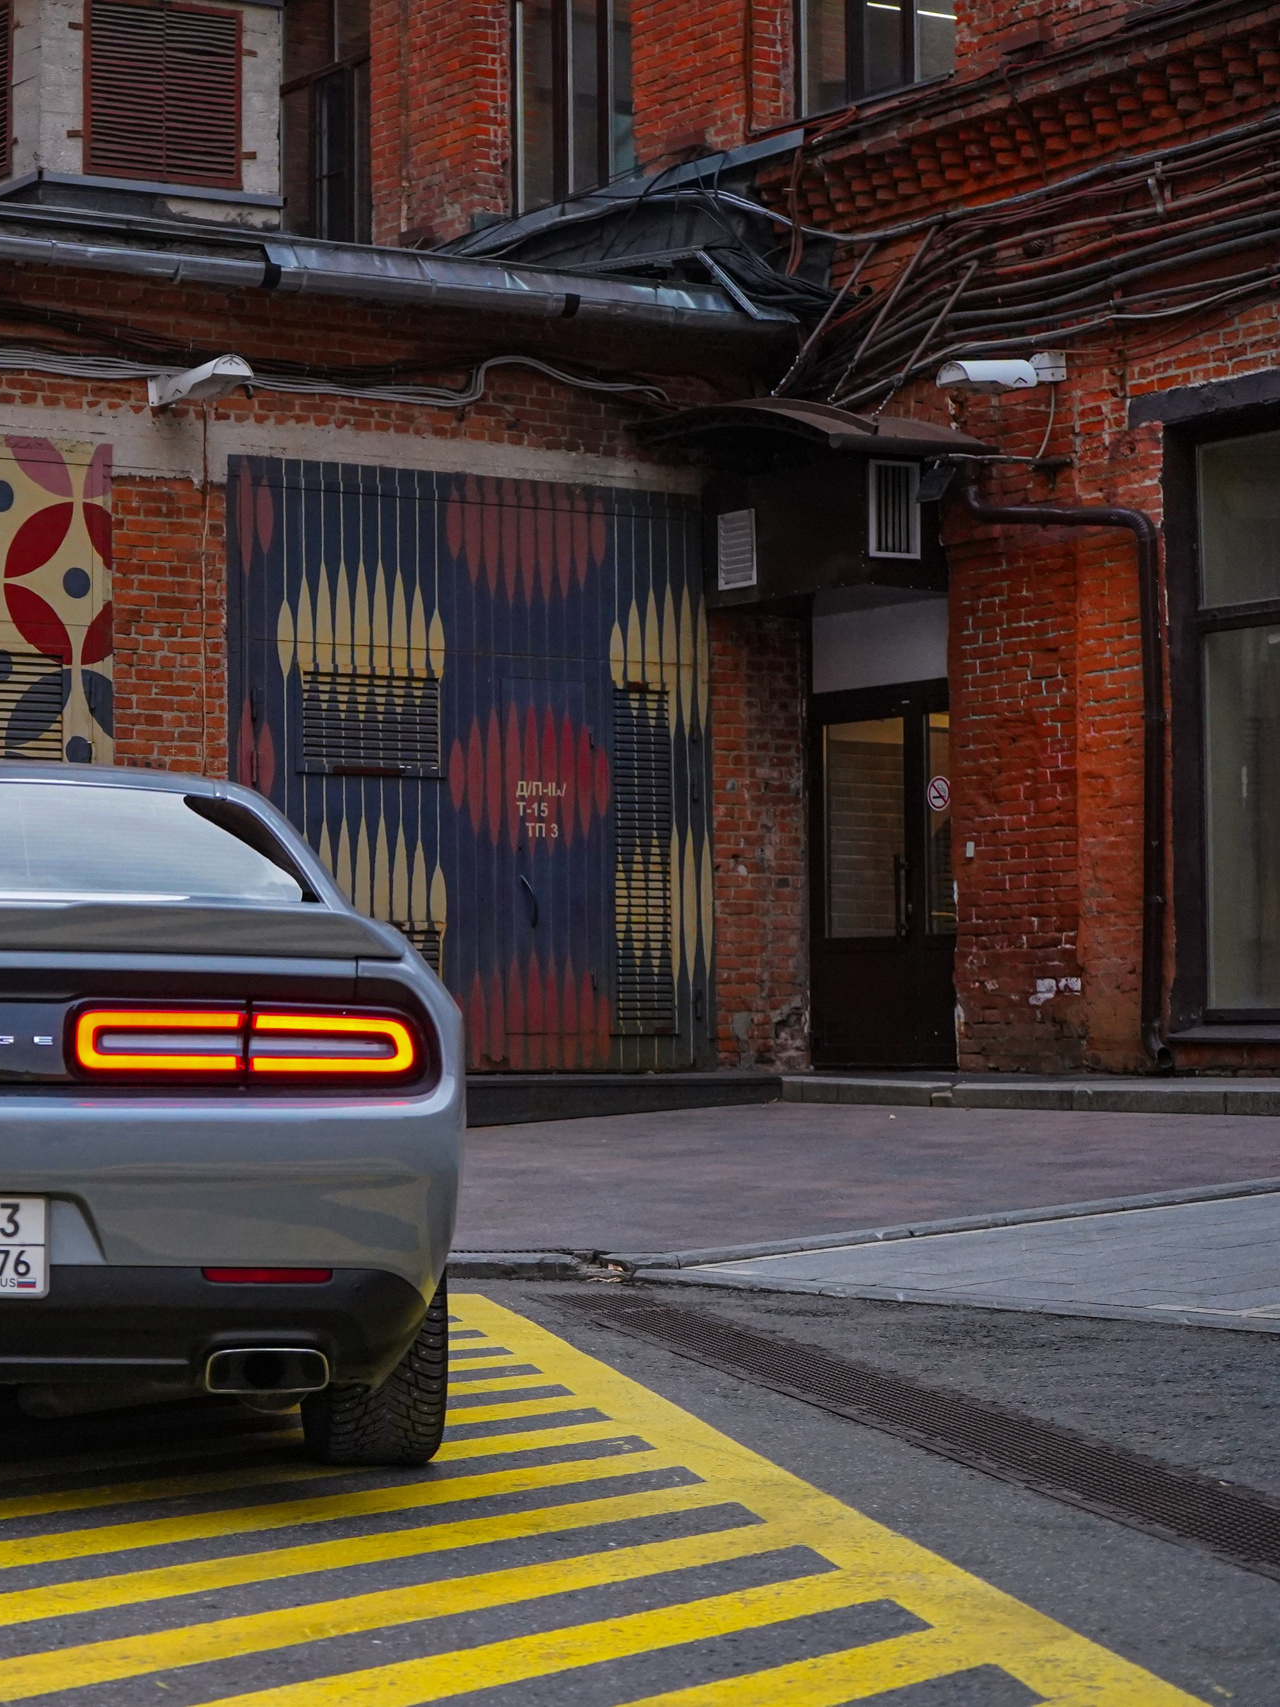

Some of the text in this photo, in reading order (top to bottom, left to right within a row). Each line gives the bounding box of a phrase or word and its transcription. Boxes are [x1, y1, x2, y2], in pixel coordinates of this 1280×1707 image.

[516, 801, 549, 818] Т-15
[525, 822, 559, 838] ТП 3
